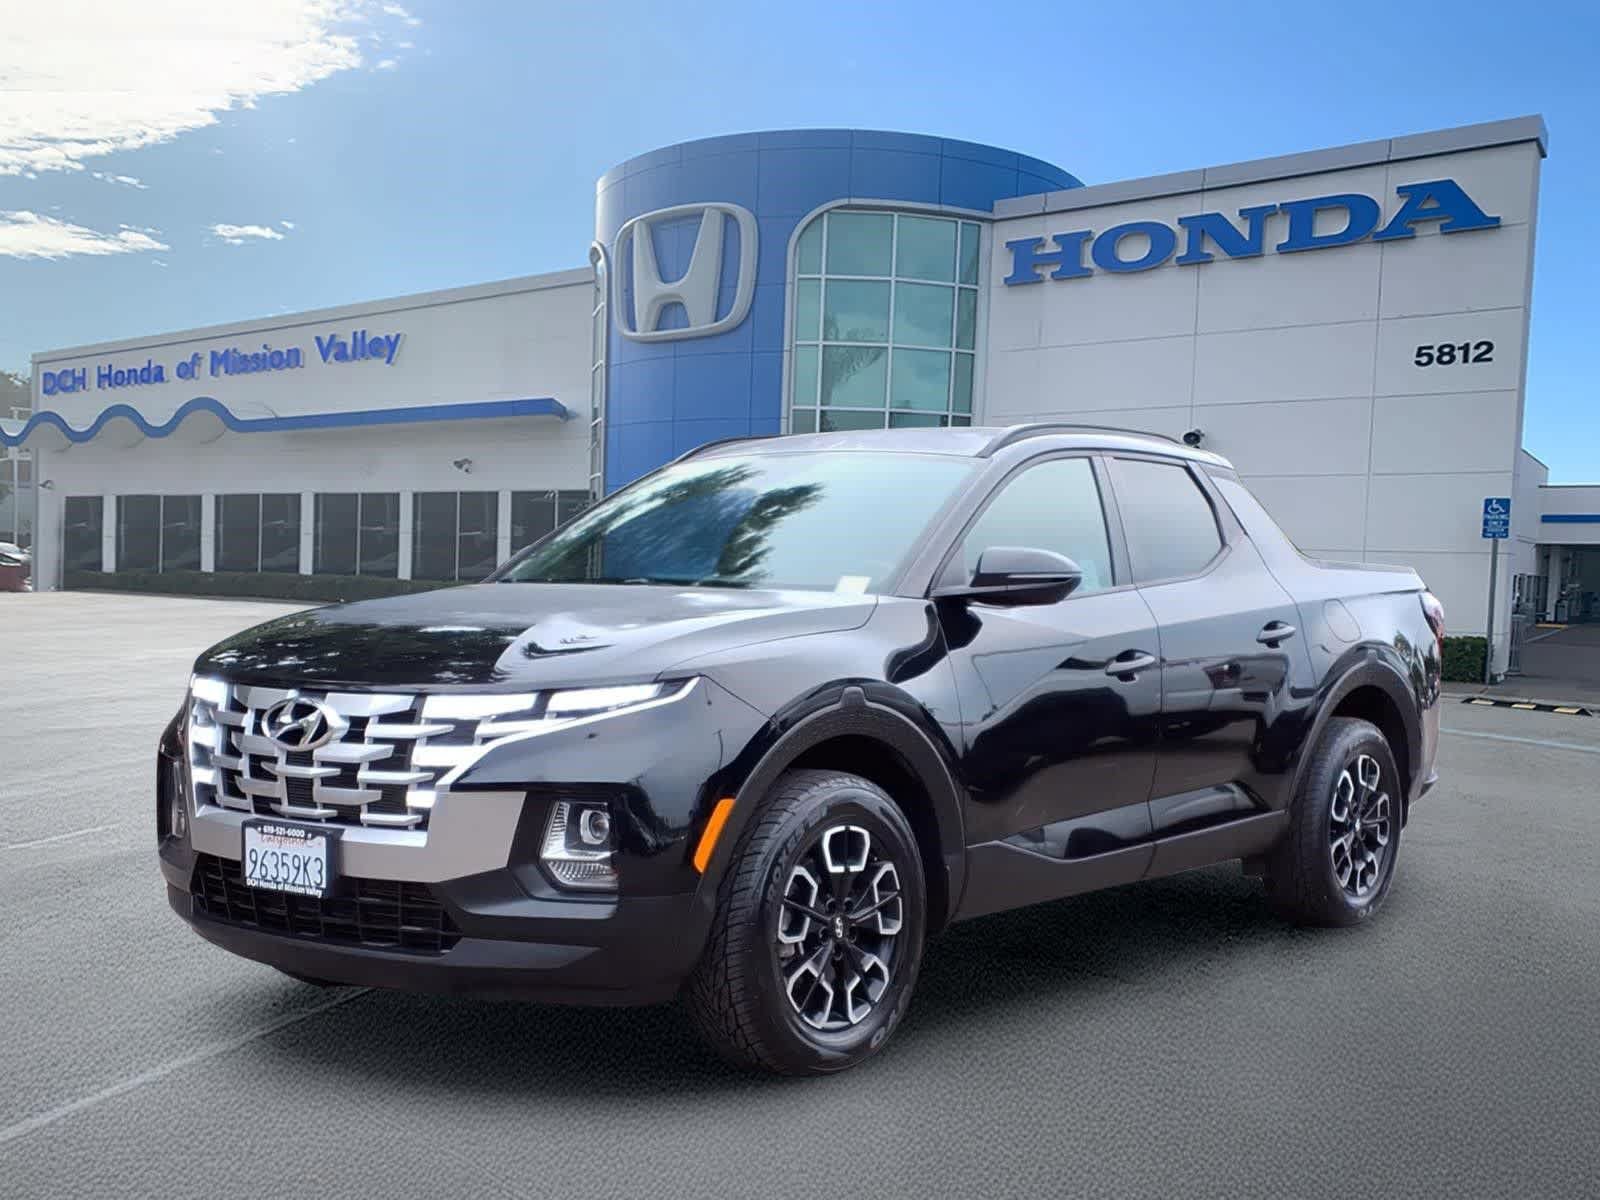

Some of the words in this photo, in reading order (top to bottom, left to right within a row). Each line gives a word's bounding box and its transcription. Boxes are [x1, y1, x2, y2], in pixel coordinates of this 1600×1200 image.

[1003, 178, 1502, 287] HONDA
[42, 367, 87, 396] DCH
[97, 358, 166, 389] Honda
[176, 352, 203, 379] of
[209, 343, 304, 377] Mission
[314, 329, 402, 366] Valley
[1414, 340, 1494, 368] 5812
[248, 848, 324, 887] 96359K3
